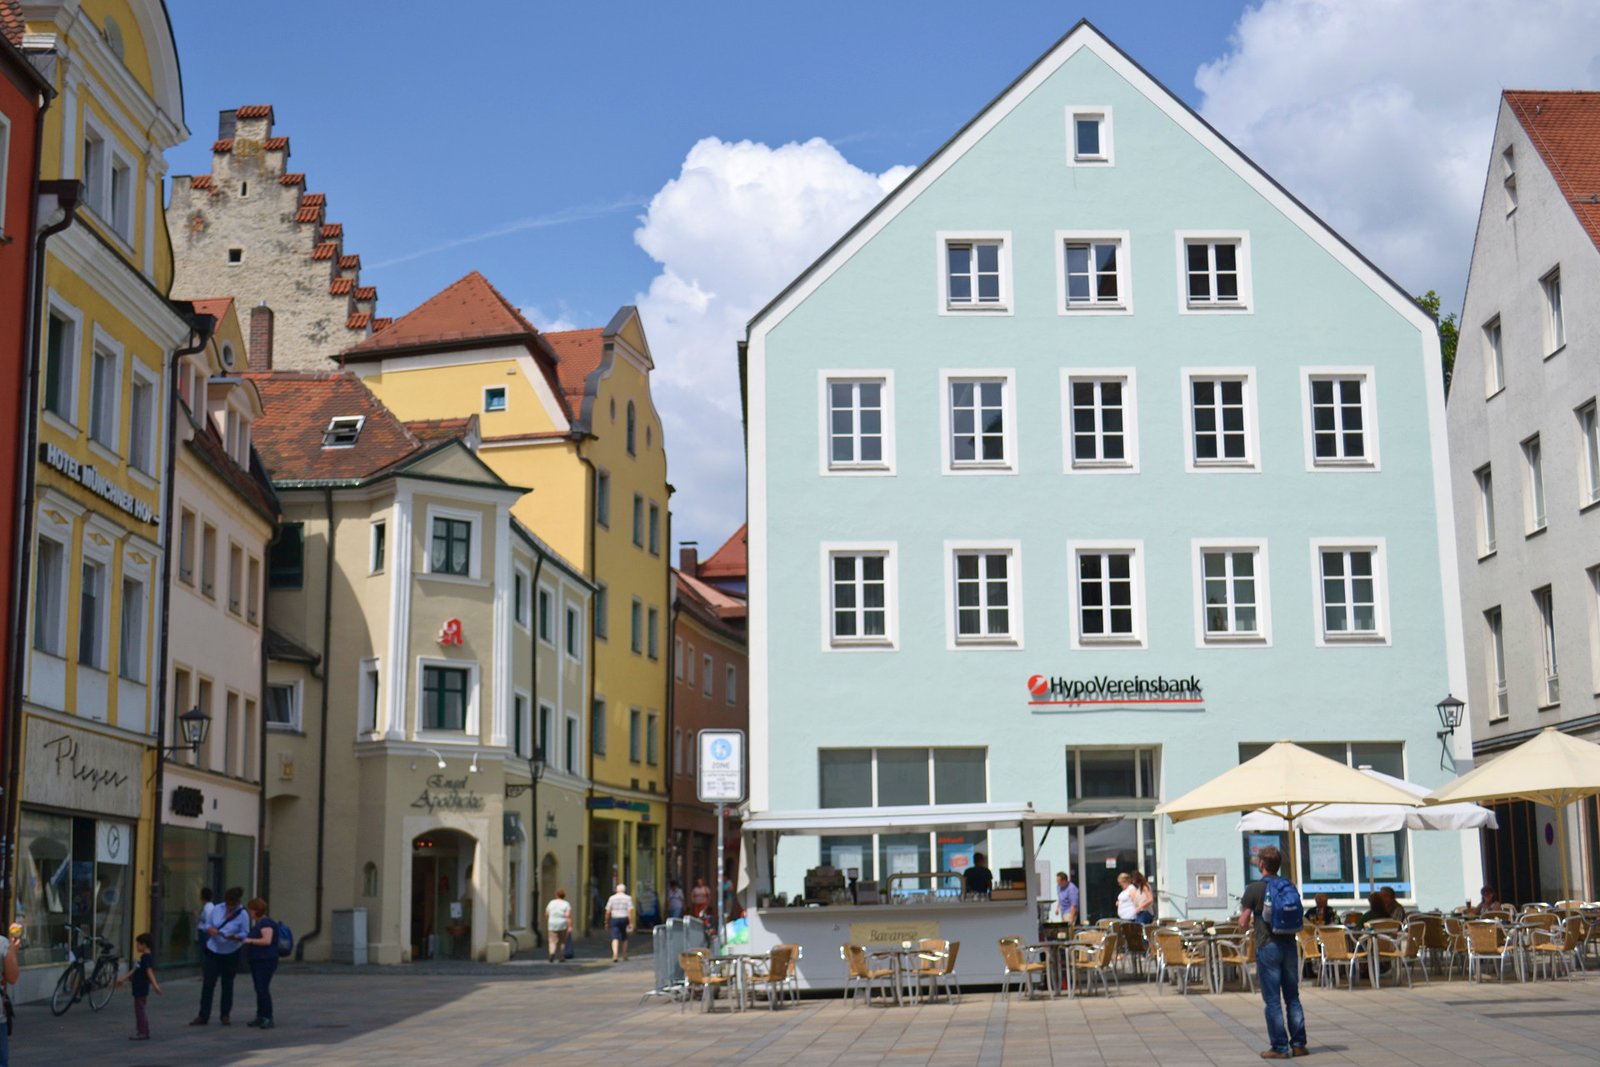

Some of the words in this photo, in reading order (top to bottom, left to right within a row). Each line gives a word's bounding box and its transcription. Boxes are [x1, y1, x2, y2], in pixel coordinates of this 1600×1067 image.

[45, 442, 81, 482] HOTEL
[81, 465, 134, 514] MÜNCHNER
[1050, 675, 1202, 699] HypoVereinsbank
